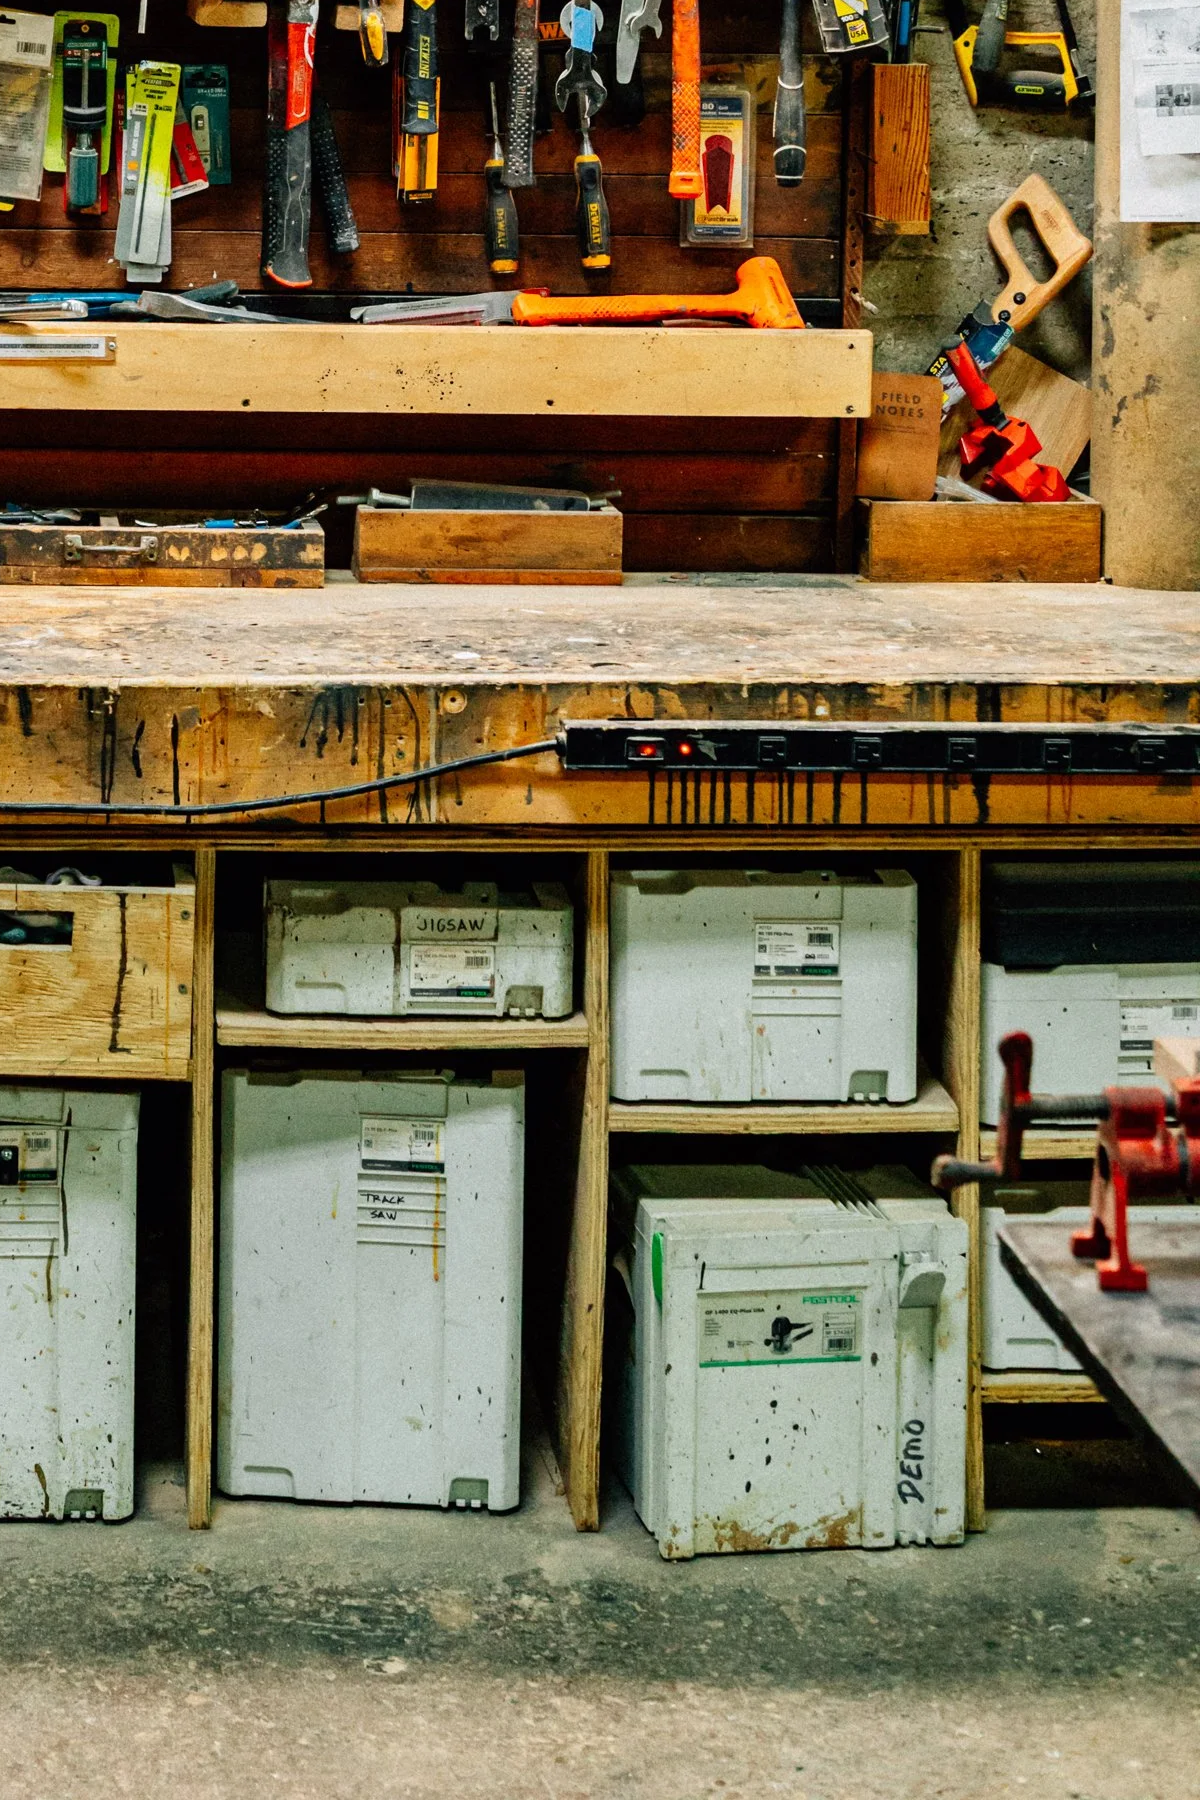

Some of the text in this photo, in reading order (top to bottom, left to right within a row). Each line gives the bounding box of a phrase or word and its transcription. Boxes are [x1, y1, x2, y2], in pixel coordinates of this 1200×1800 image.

[850, 29, 867, 39] USA
[418, 34, 431, 80] ESTWING
[701, 103, 715, 111] 80
[494, 207, 506, 249] DEWALT
[589, 203, 602, 245] DEWALT
[881, 391, 921, 405] FIELD
[875, 404, 924, 419] NOTES
[416, 918, 485, 932] JIGSAW
[360, 1193, 405, 1204] TRACK
[370, 1209, 398, 1221] SAW
[802, 1293, 861, 1305] FESTOOL
